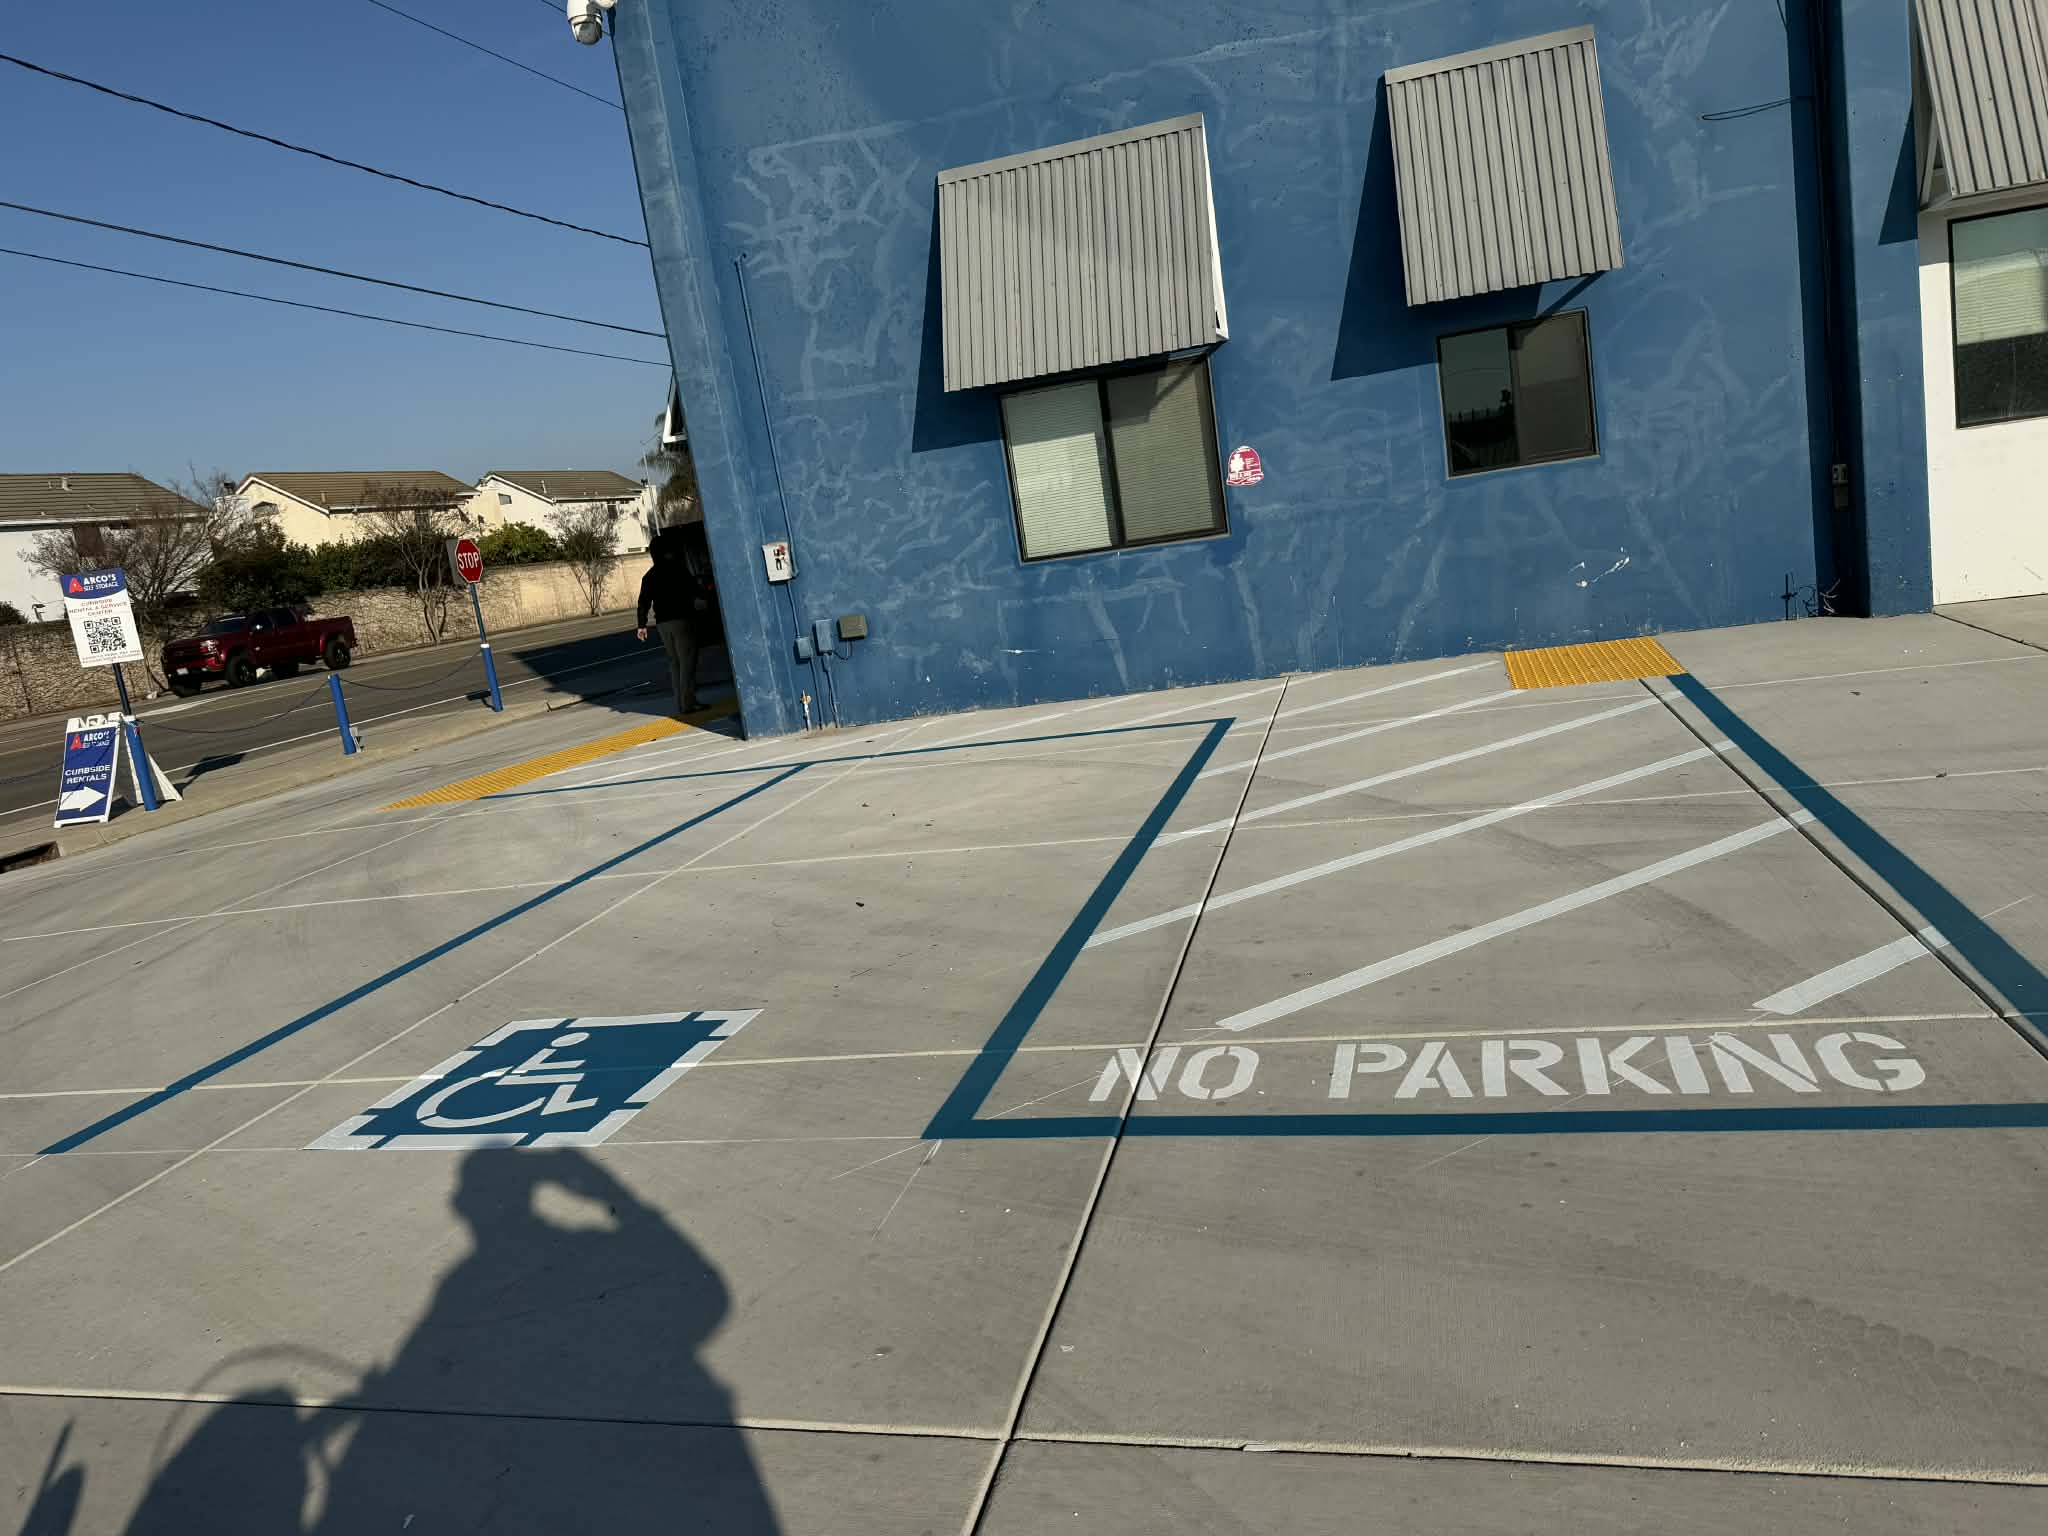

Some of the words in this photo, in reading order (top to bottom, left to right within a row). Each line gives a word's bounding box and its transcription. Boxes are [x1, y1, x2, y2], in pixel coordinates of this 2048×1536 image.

[457, 551, 479, 569] STOP
[83, 574, 116, 585] ARCO'S
[65, 765, 110, 776] CURBSIDE
[67, 774, 106, 784] RENTALS
[1088, 1046, 1260, 1101] NO
[1328, 1031, 1927, 1099] PARKING
